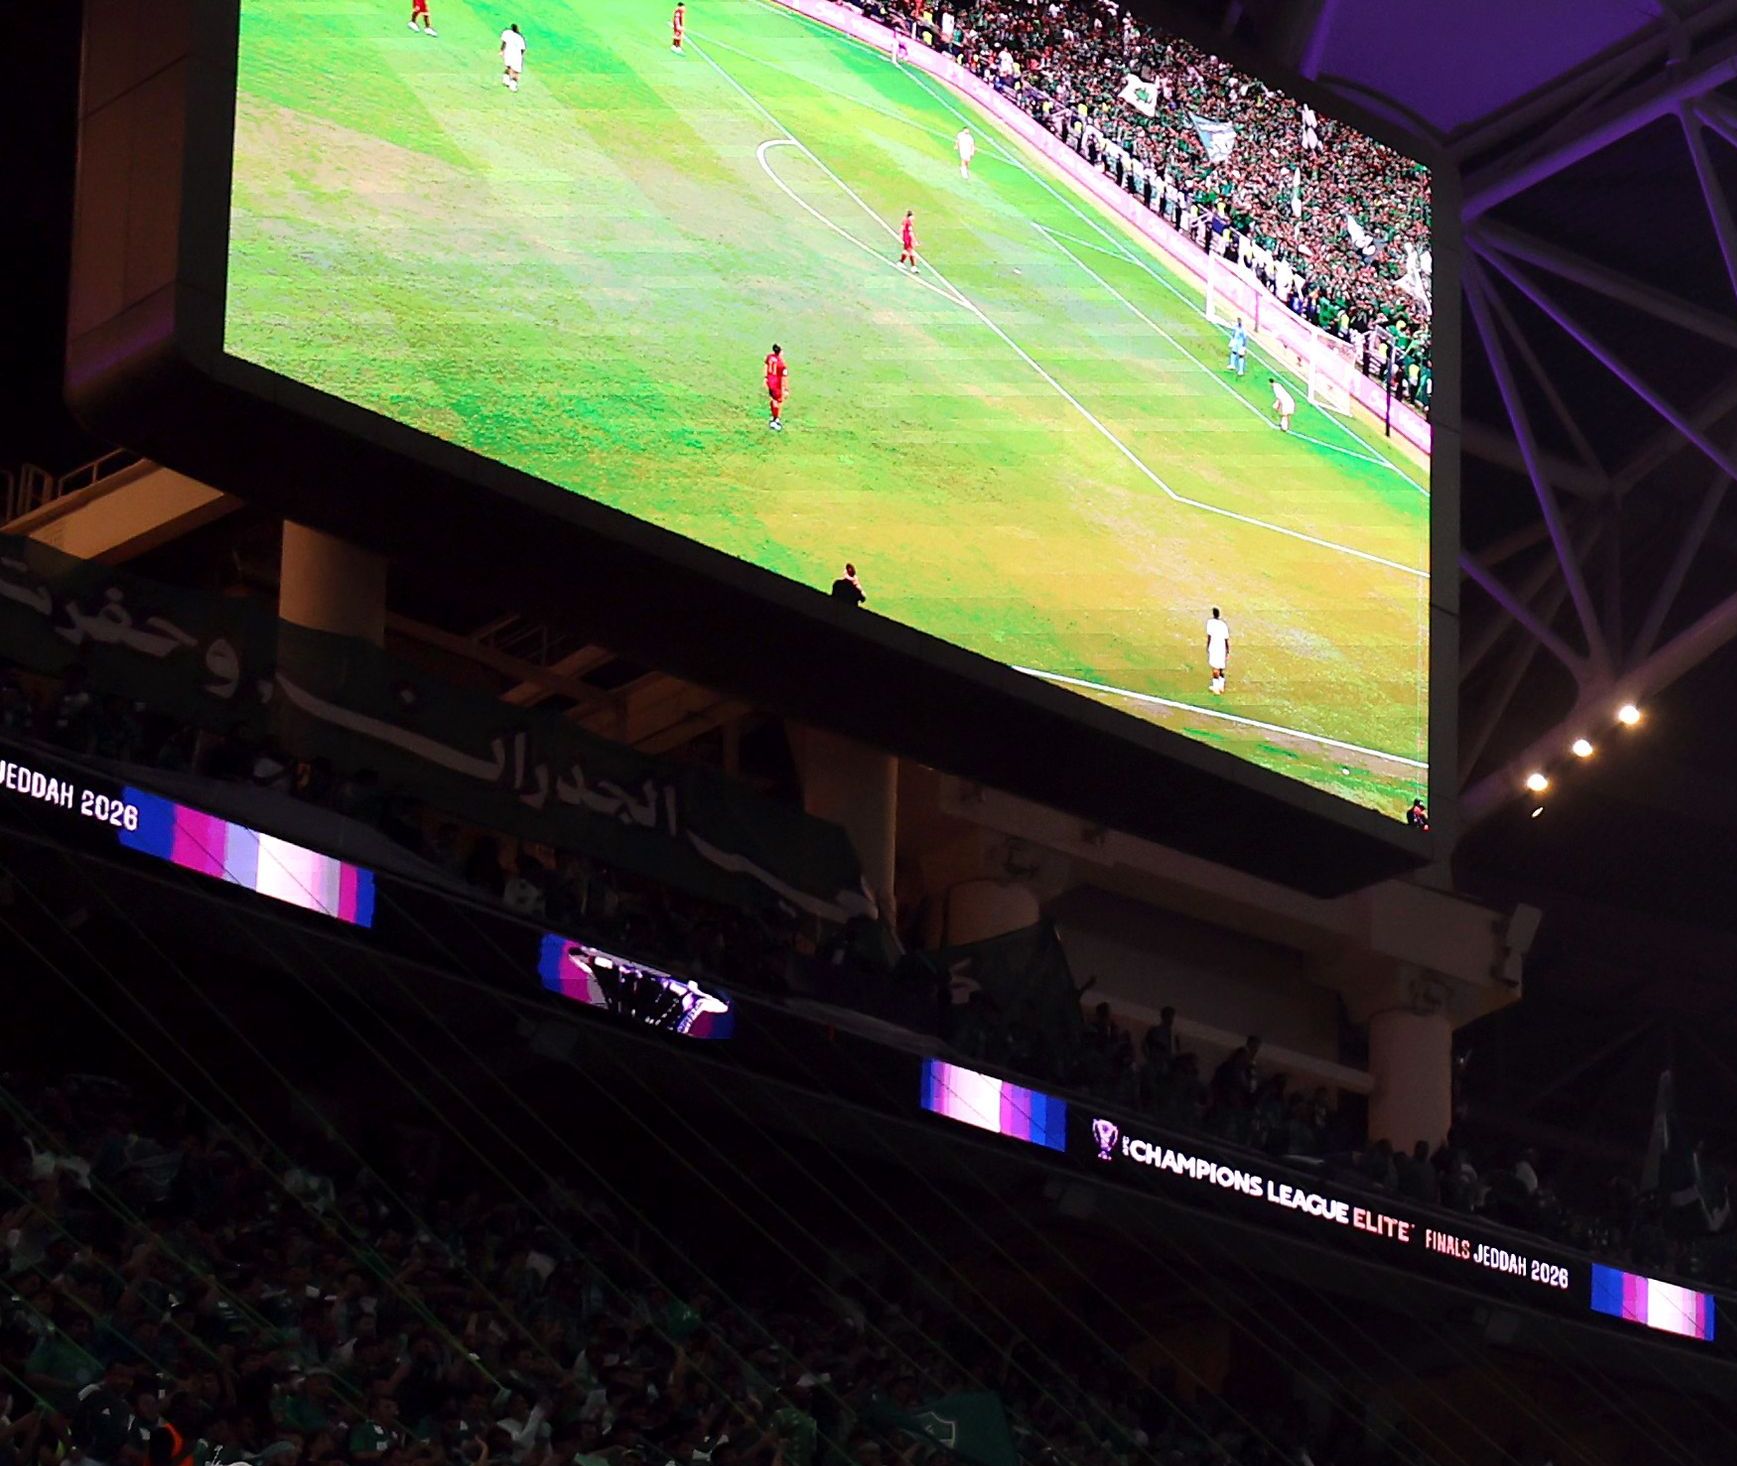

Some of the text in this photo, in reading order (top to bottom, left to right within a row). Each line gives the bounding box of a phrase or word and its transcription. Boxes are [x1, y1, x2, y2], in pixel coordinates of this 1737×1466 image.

[80, 789, 139, 832] 2026
[1129, 1139, 1569, 1290] CHAMPIONS LEAGUE ELITE FINALS JEDDAH 2026
